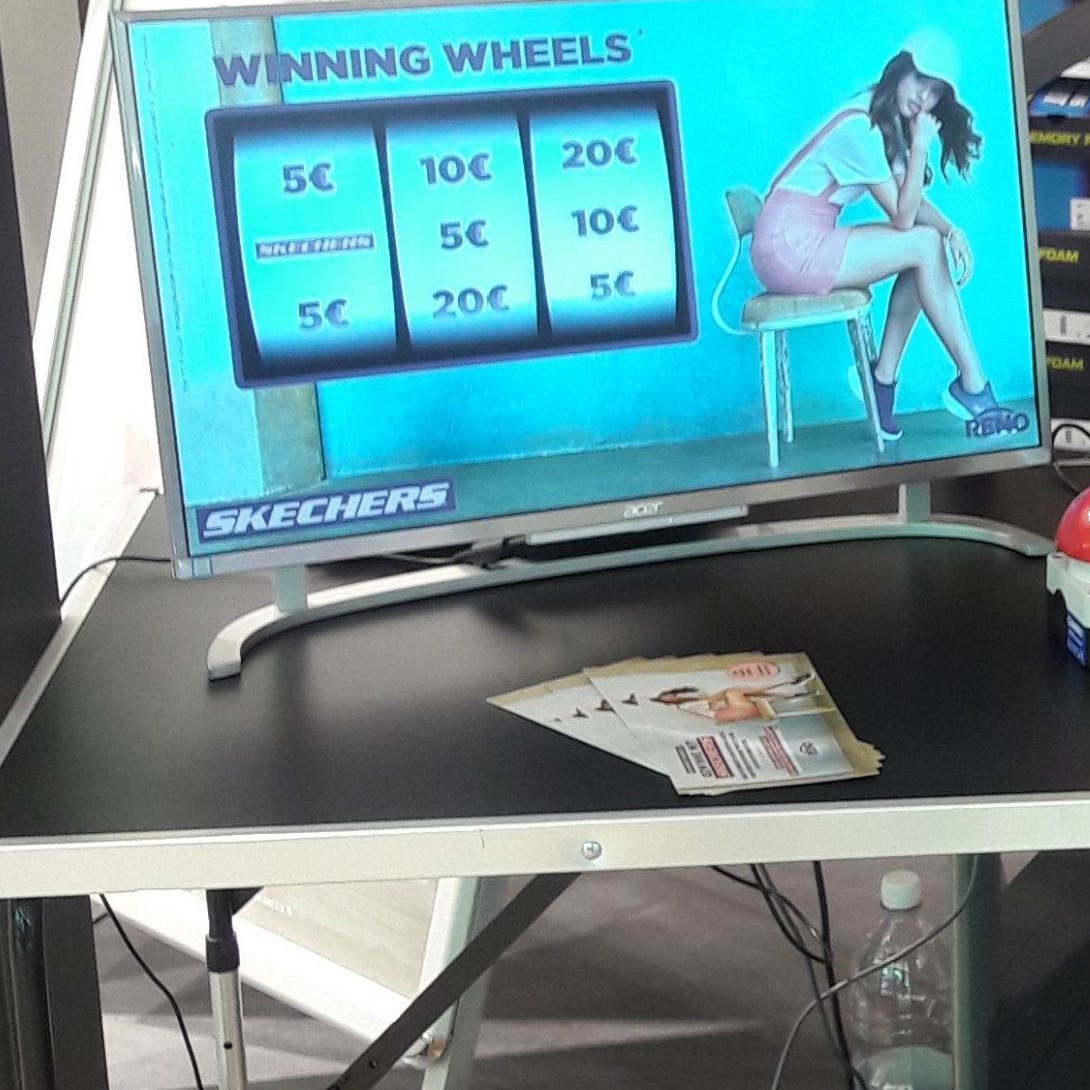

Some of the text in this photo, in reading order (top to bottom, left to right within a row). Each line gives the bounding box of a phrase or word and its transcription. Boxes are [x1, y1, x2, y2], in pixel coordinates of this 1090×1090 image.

[213, 32, 632, 87] WINNING WHEELS
[282, 137, 638, 195] 5€ 10€ 20€
[1029, 130, 1081, 146] EMORY
[440, 205, 639, 250] 5€ 10€
[298, 271, 637, 330] 5€ 20€ 5€
[203, 481, 450, 538] SKECHERS
